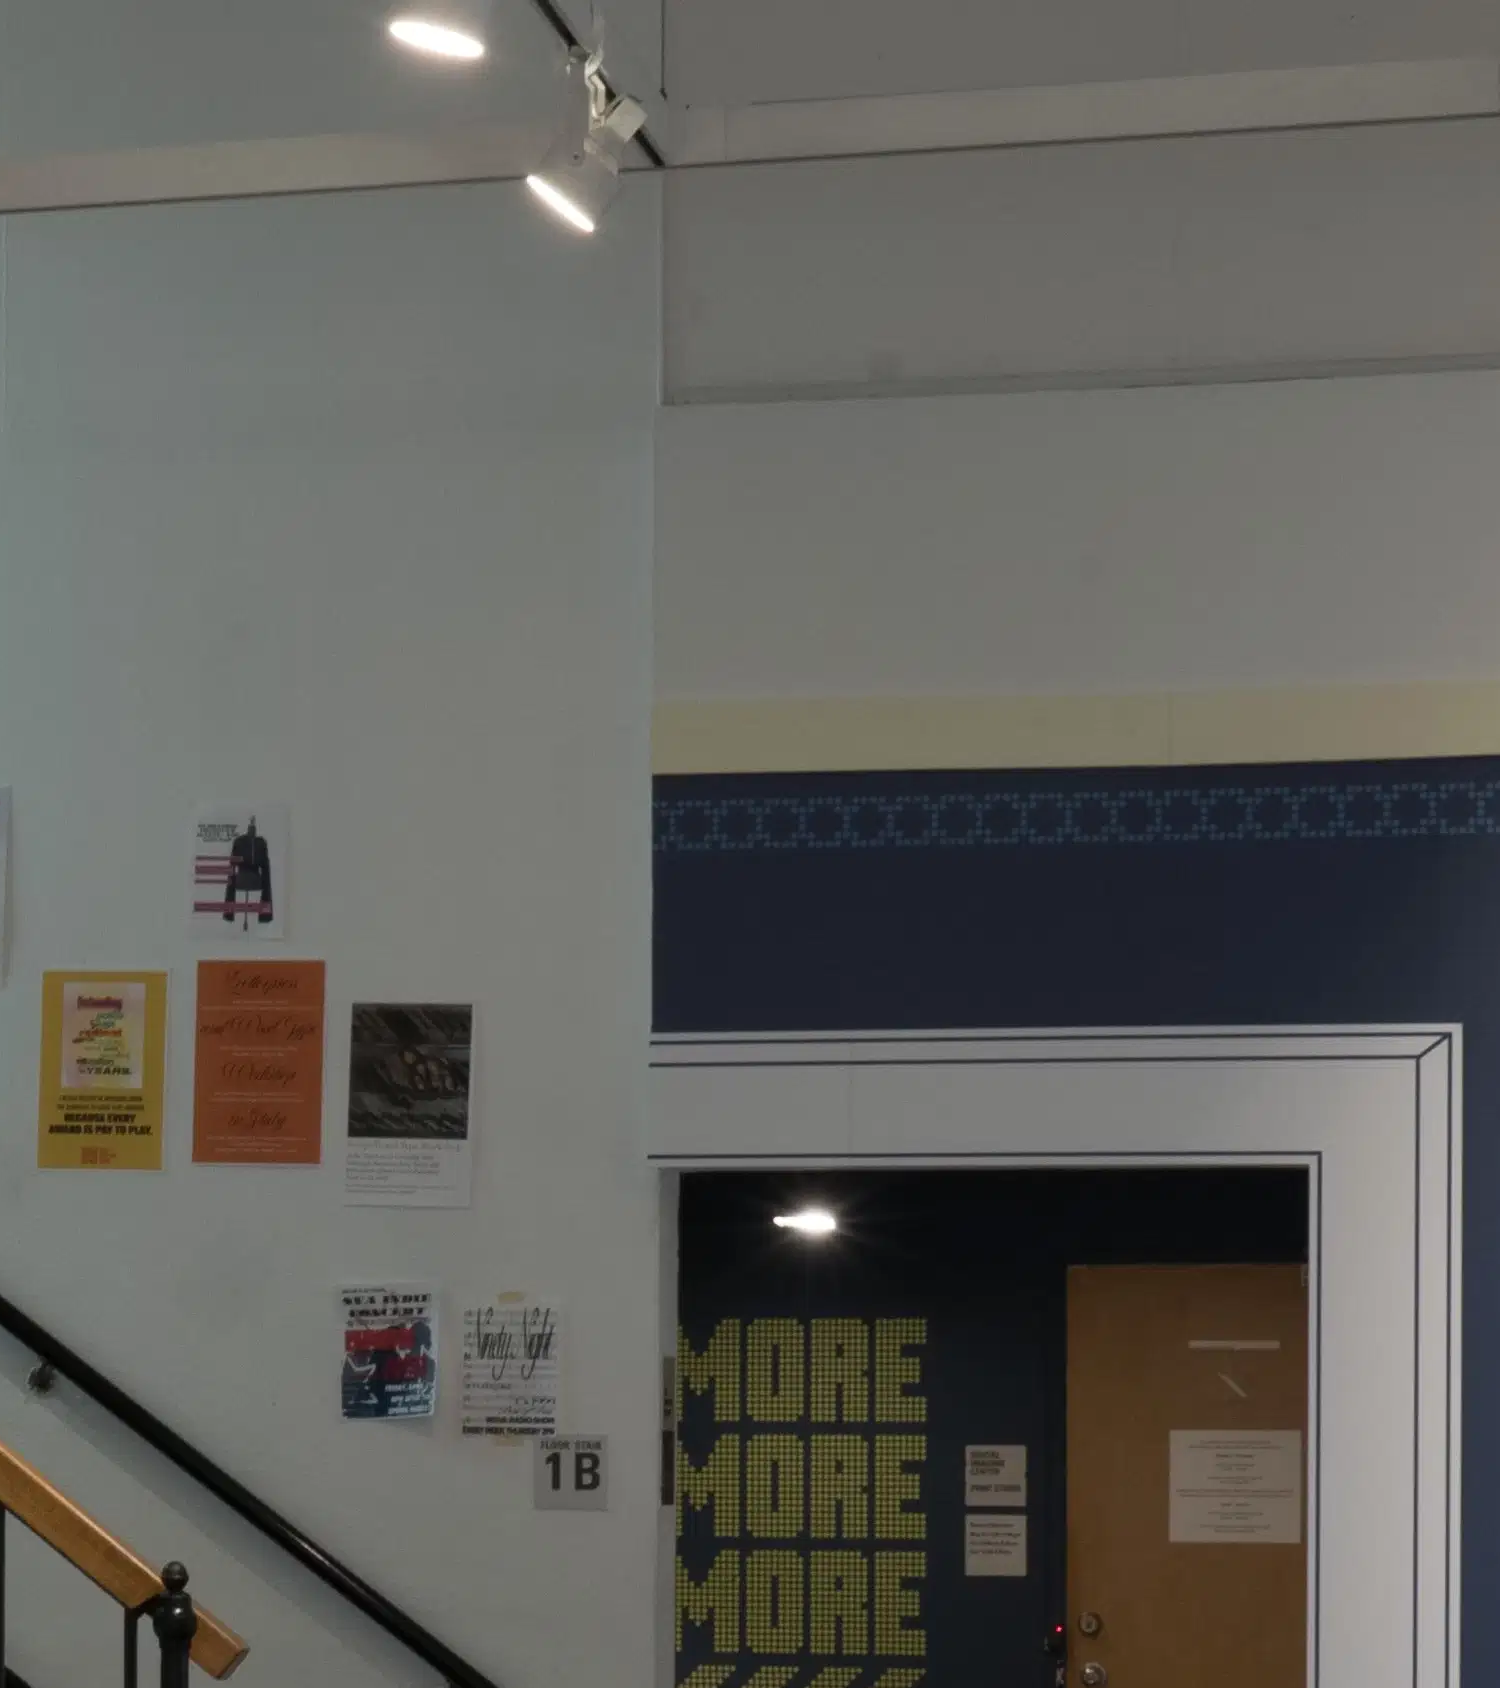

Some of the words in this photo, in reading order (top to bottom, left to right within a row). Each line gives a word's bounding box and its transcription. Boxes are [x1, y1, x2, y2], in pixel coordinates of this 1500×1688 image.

[64, 1113, 105, 1123] BECAUSE
[107, 1113, 136, 1123] EVERY
[674, 1318, 928, 1423] MORE
[545, 1452, 560, 1491] 1
[575, 1452, 601, 1491] B
[674, 1434, 928, 1540] MORE
[674, 1549, 928, 1656] MORE
